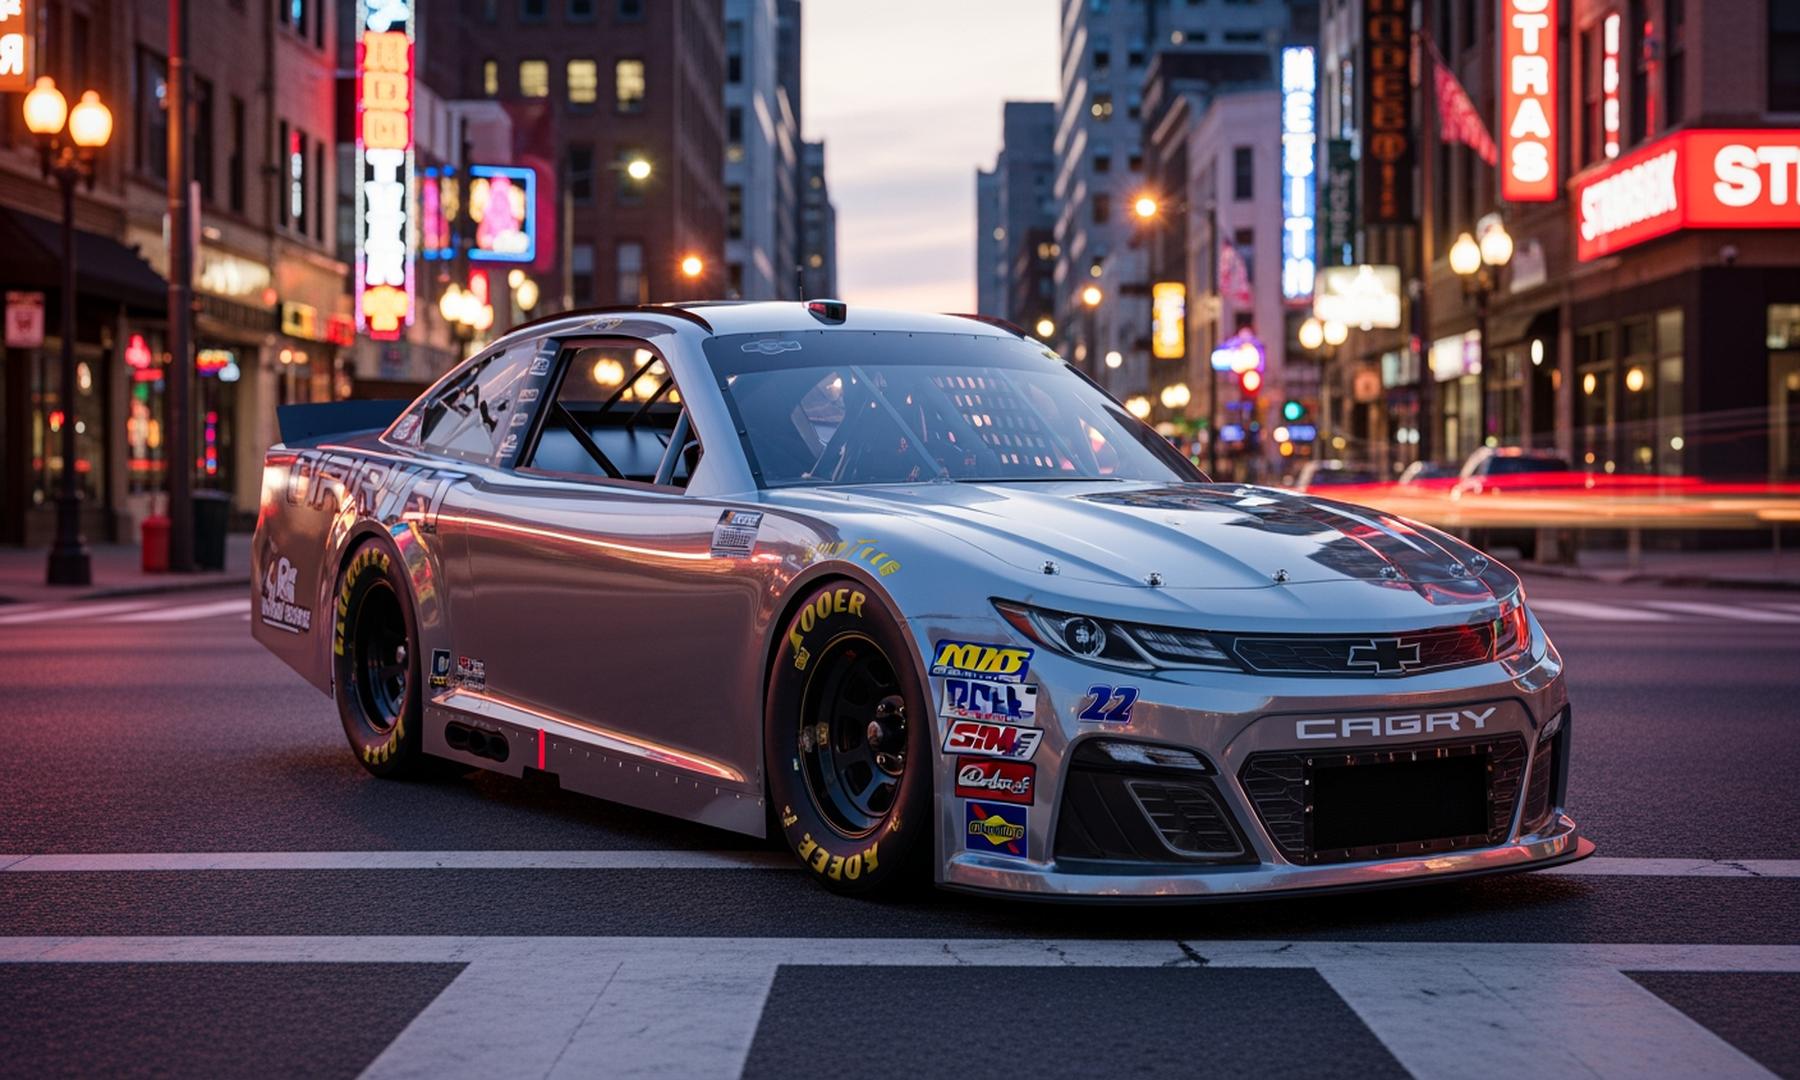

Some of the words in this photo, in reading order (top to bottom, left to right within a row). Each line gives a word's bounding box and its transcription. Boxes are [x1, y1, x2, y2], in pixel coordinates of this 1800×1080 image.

[1713, 144, 1800, 207] ST
[1079, 685, 1140, 725] 22
[1296, 707, 1497, 740] CAGRY
